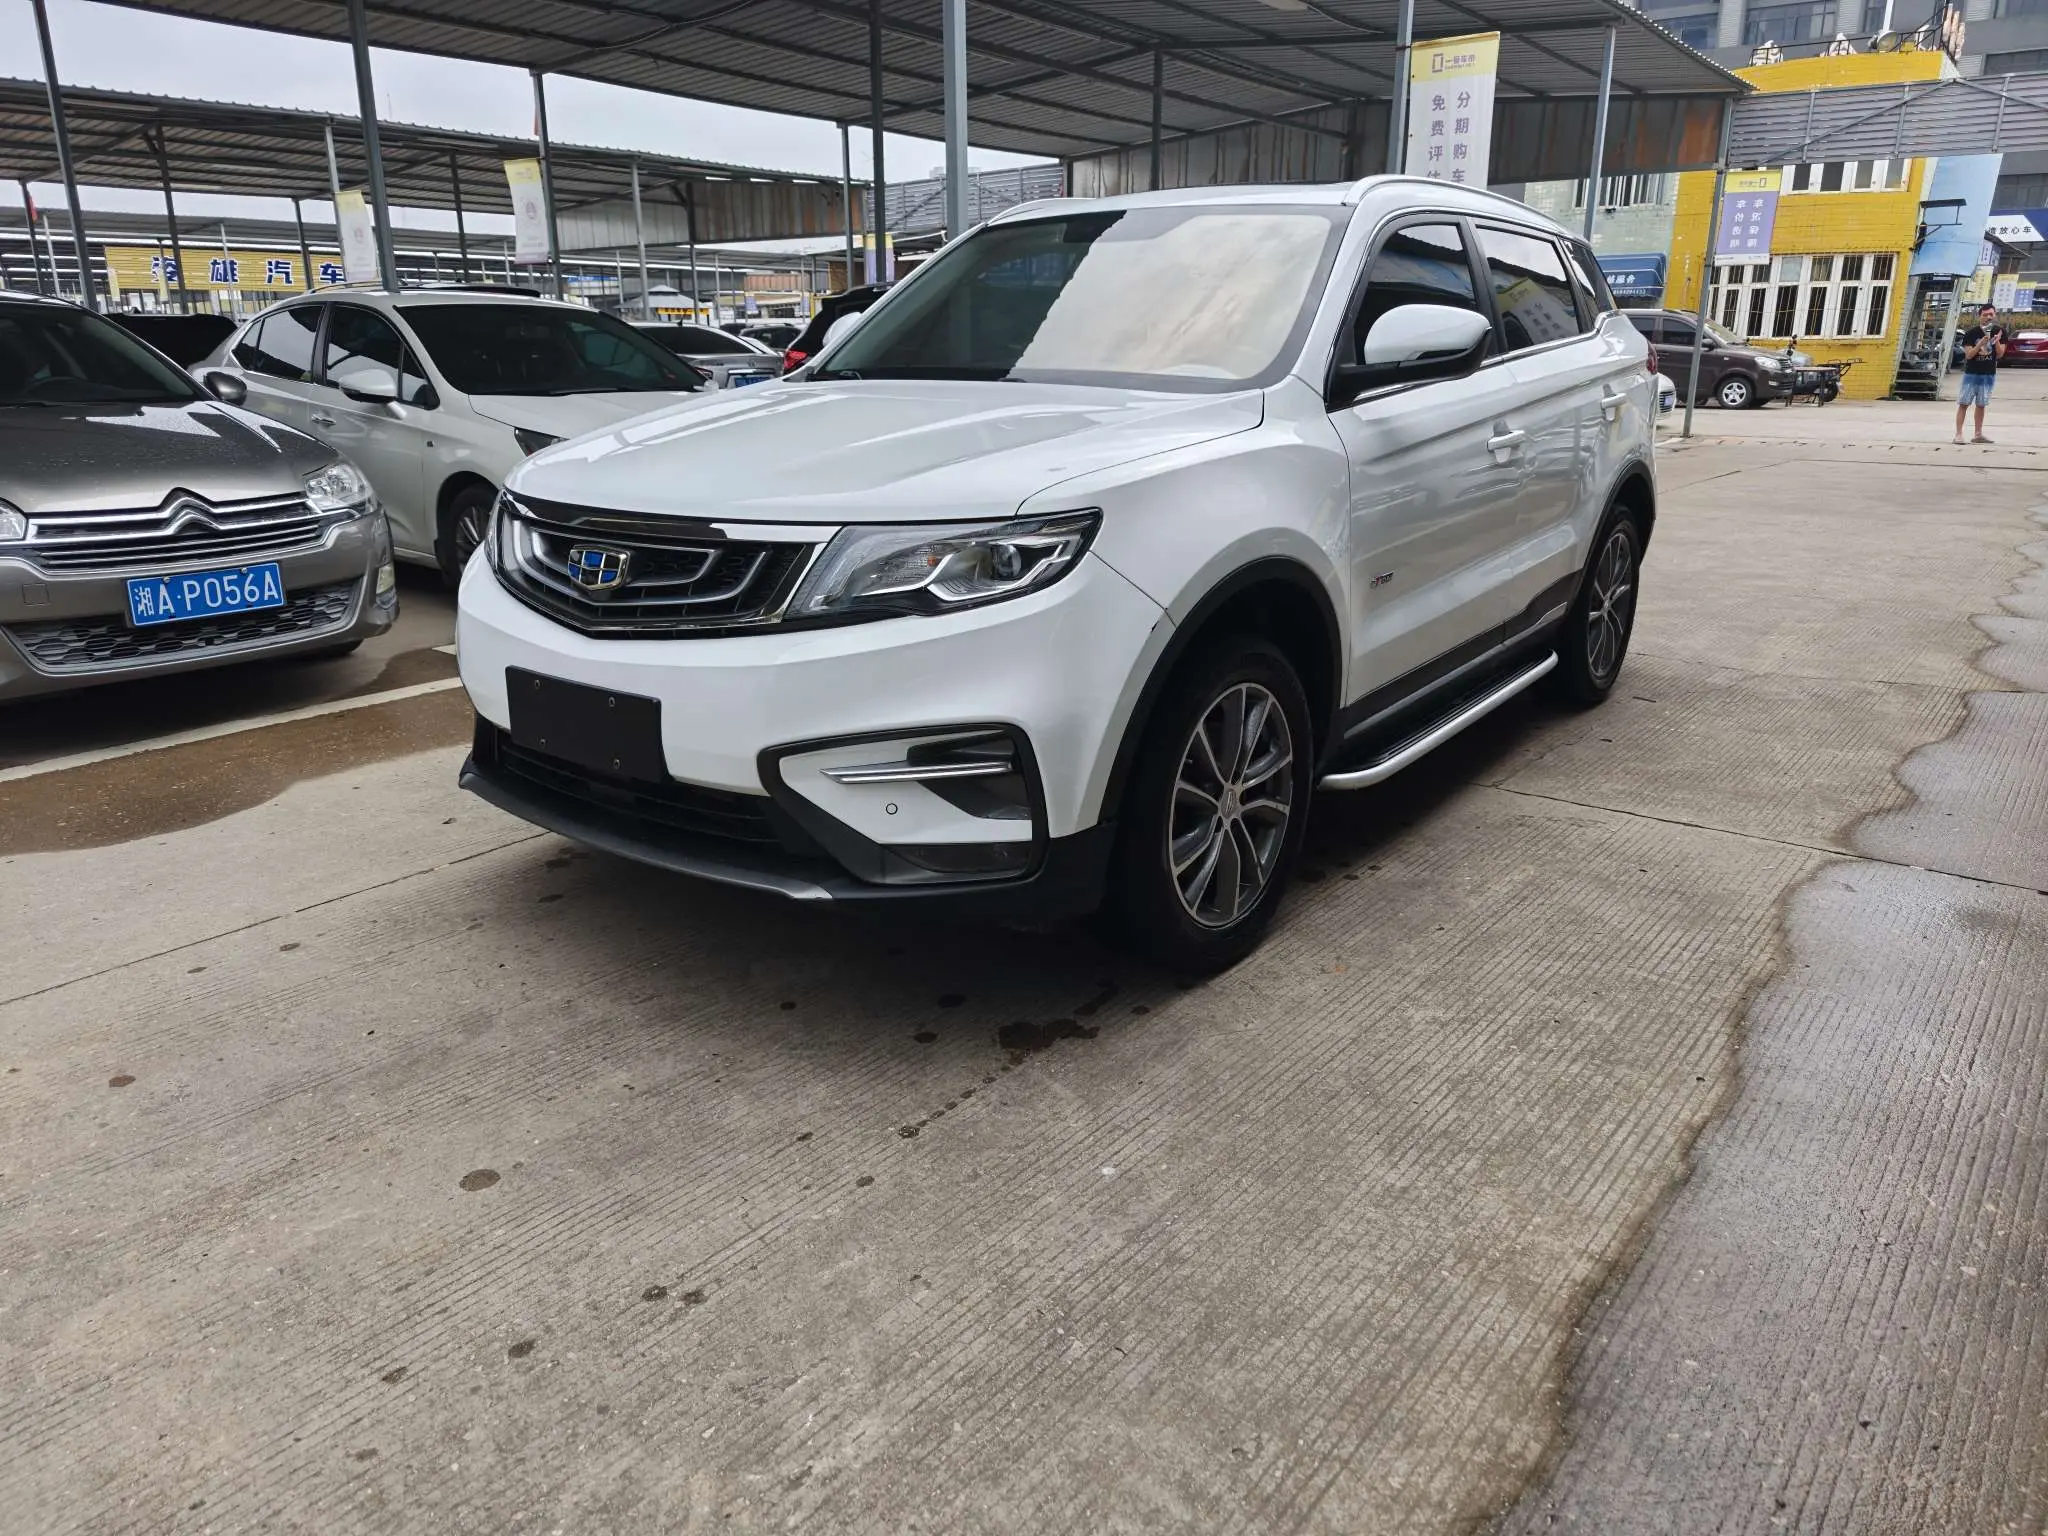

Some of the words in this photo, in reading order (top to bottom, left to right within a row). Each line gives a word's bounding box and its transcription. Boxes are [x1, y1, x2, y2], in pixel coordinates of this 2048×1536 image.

[1450, 91, 1471, 183] 分期购车
[134, 570, 279, 617] 湘A·P056A
